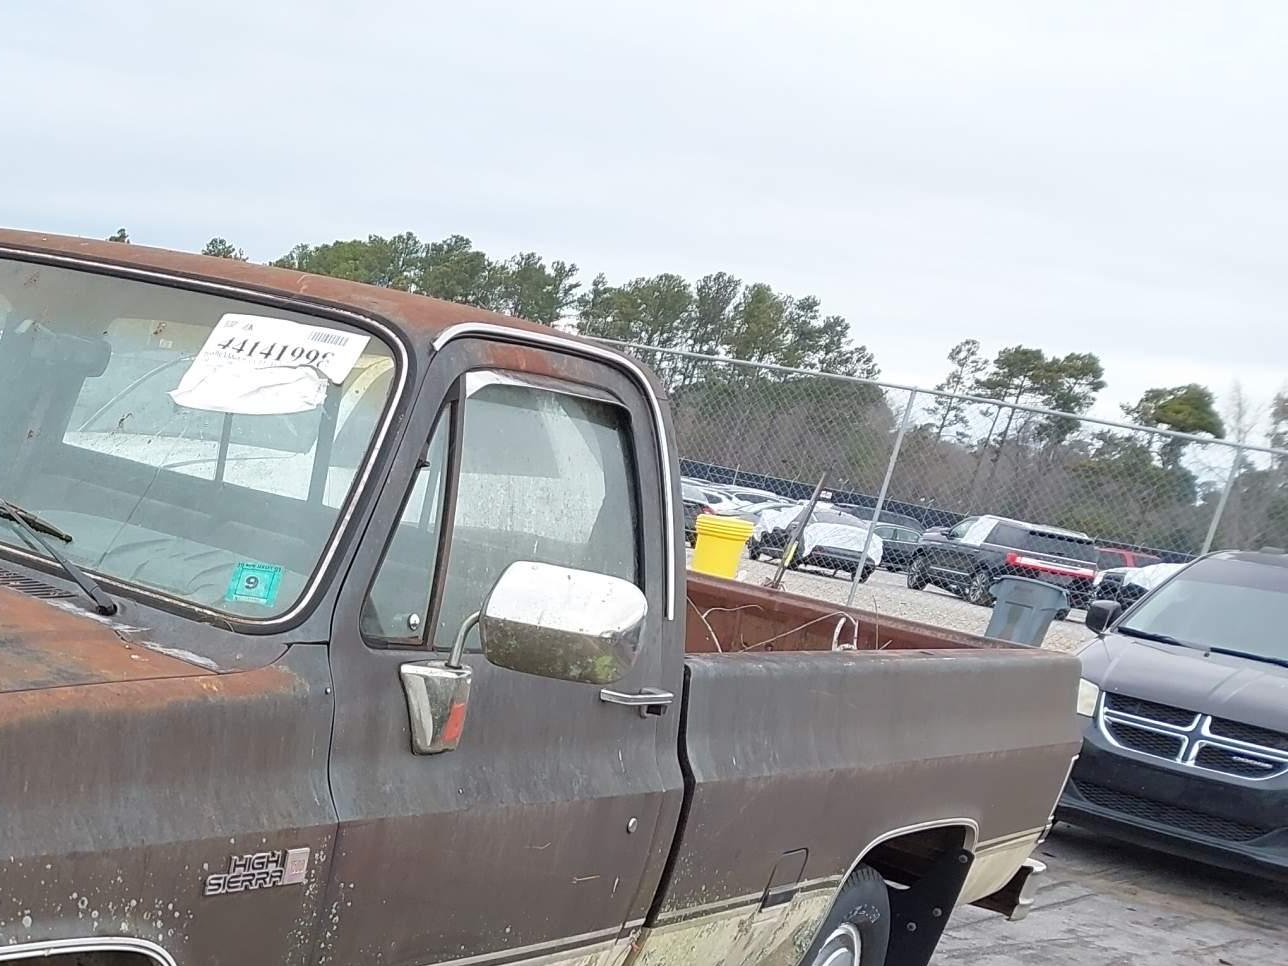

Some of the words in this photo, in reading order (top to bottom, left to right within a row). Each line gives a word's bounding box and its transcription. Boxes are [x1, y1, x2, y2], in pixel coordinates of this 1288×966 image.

[244, 575, 259, 590] 9
[228, 850, 283, 875] HIGH
[204, 868, 285, 896] SIERRA
